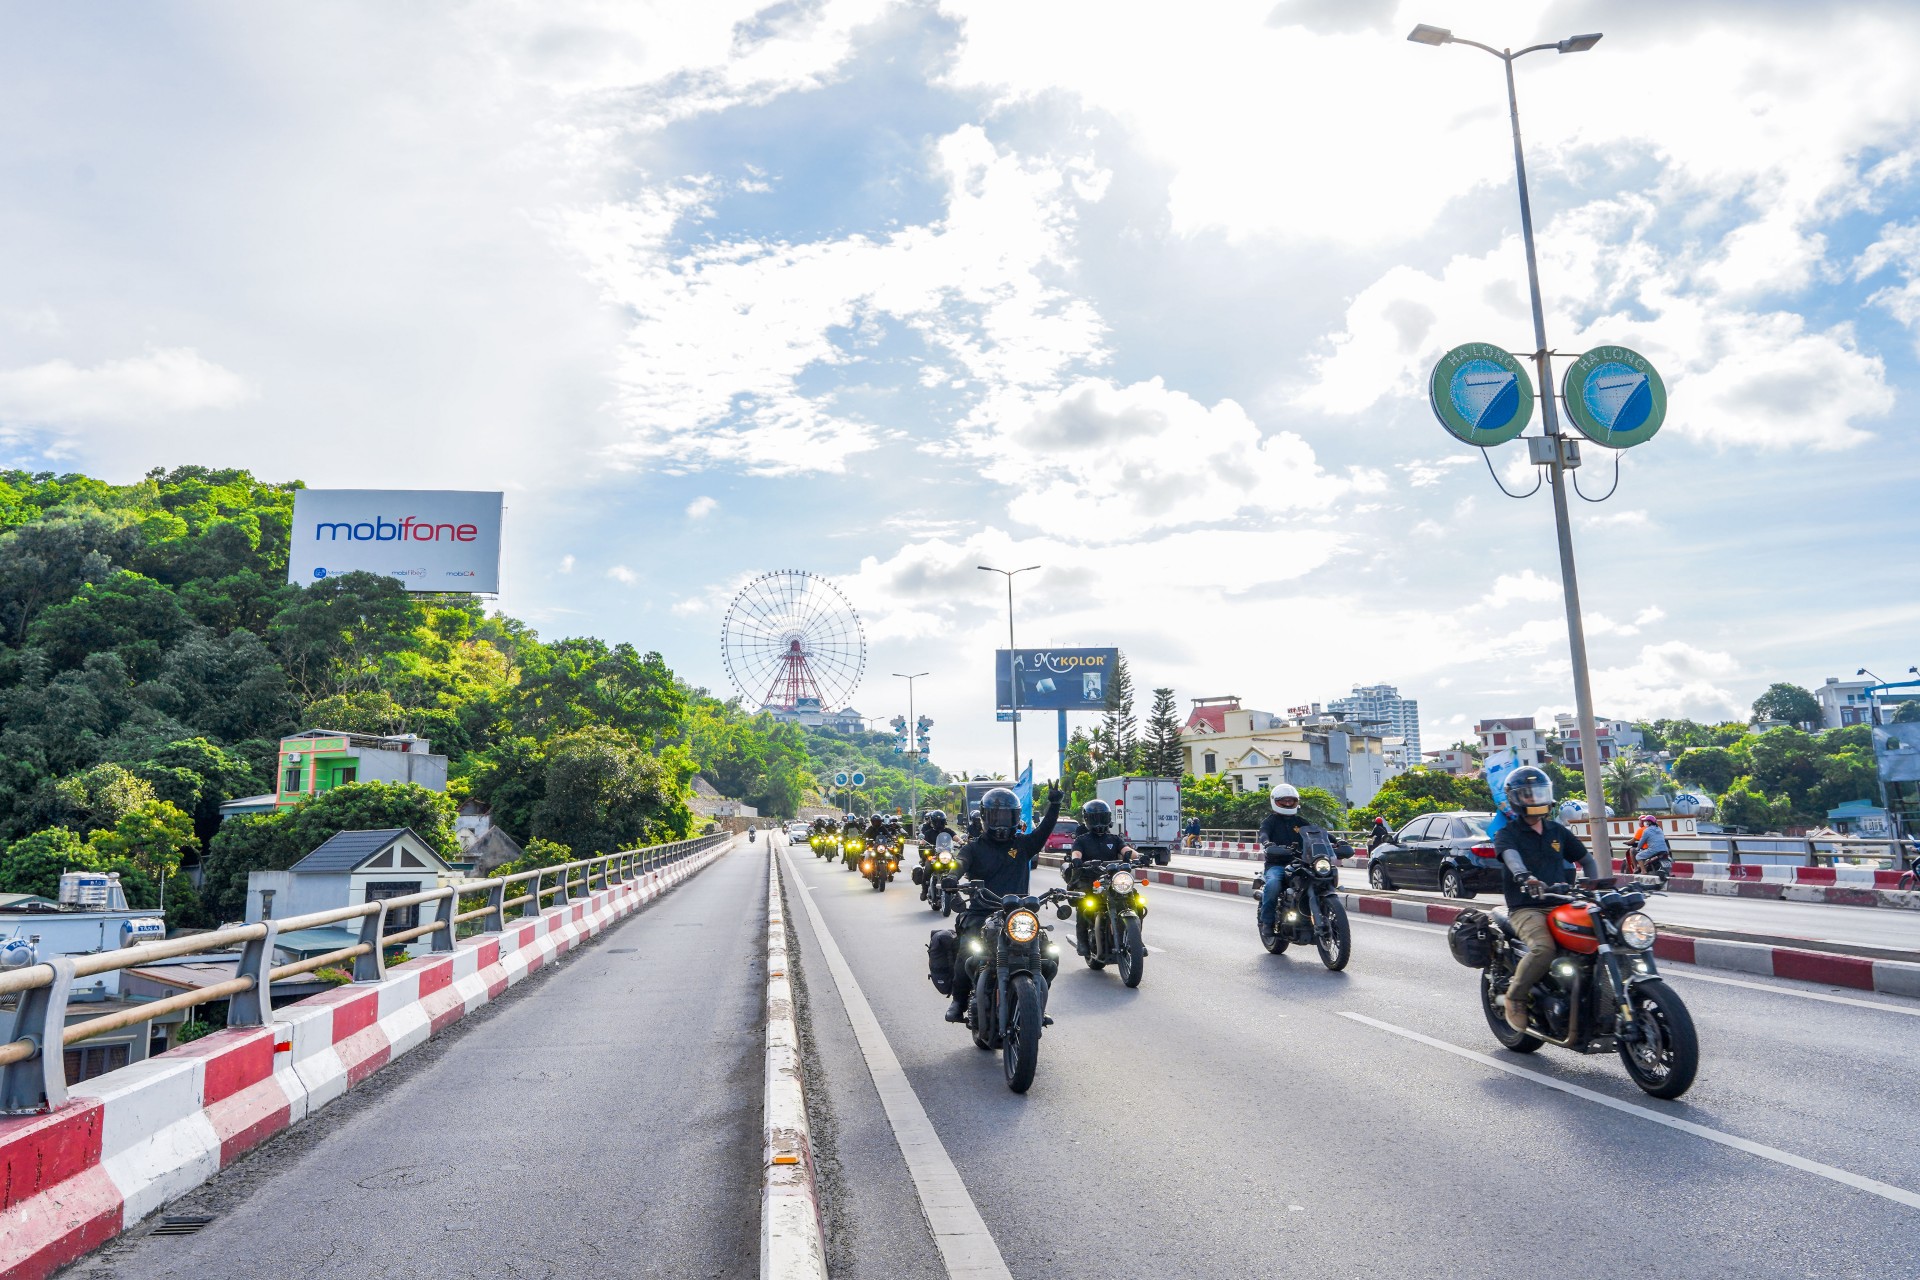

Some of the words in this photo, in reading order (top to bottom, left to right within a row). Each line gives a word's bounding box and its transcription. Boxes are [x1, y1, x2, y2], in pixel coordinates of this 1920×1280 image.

[1473, 345, 1516, 369] LONG
[1602, 349, 1647, 371] LONG
[315, 515, 478, 542] mobifone
